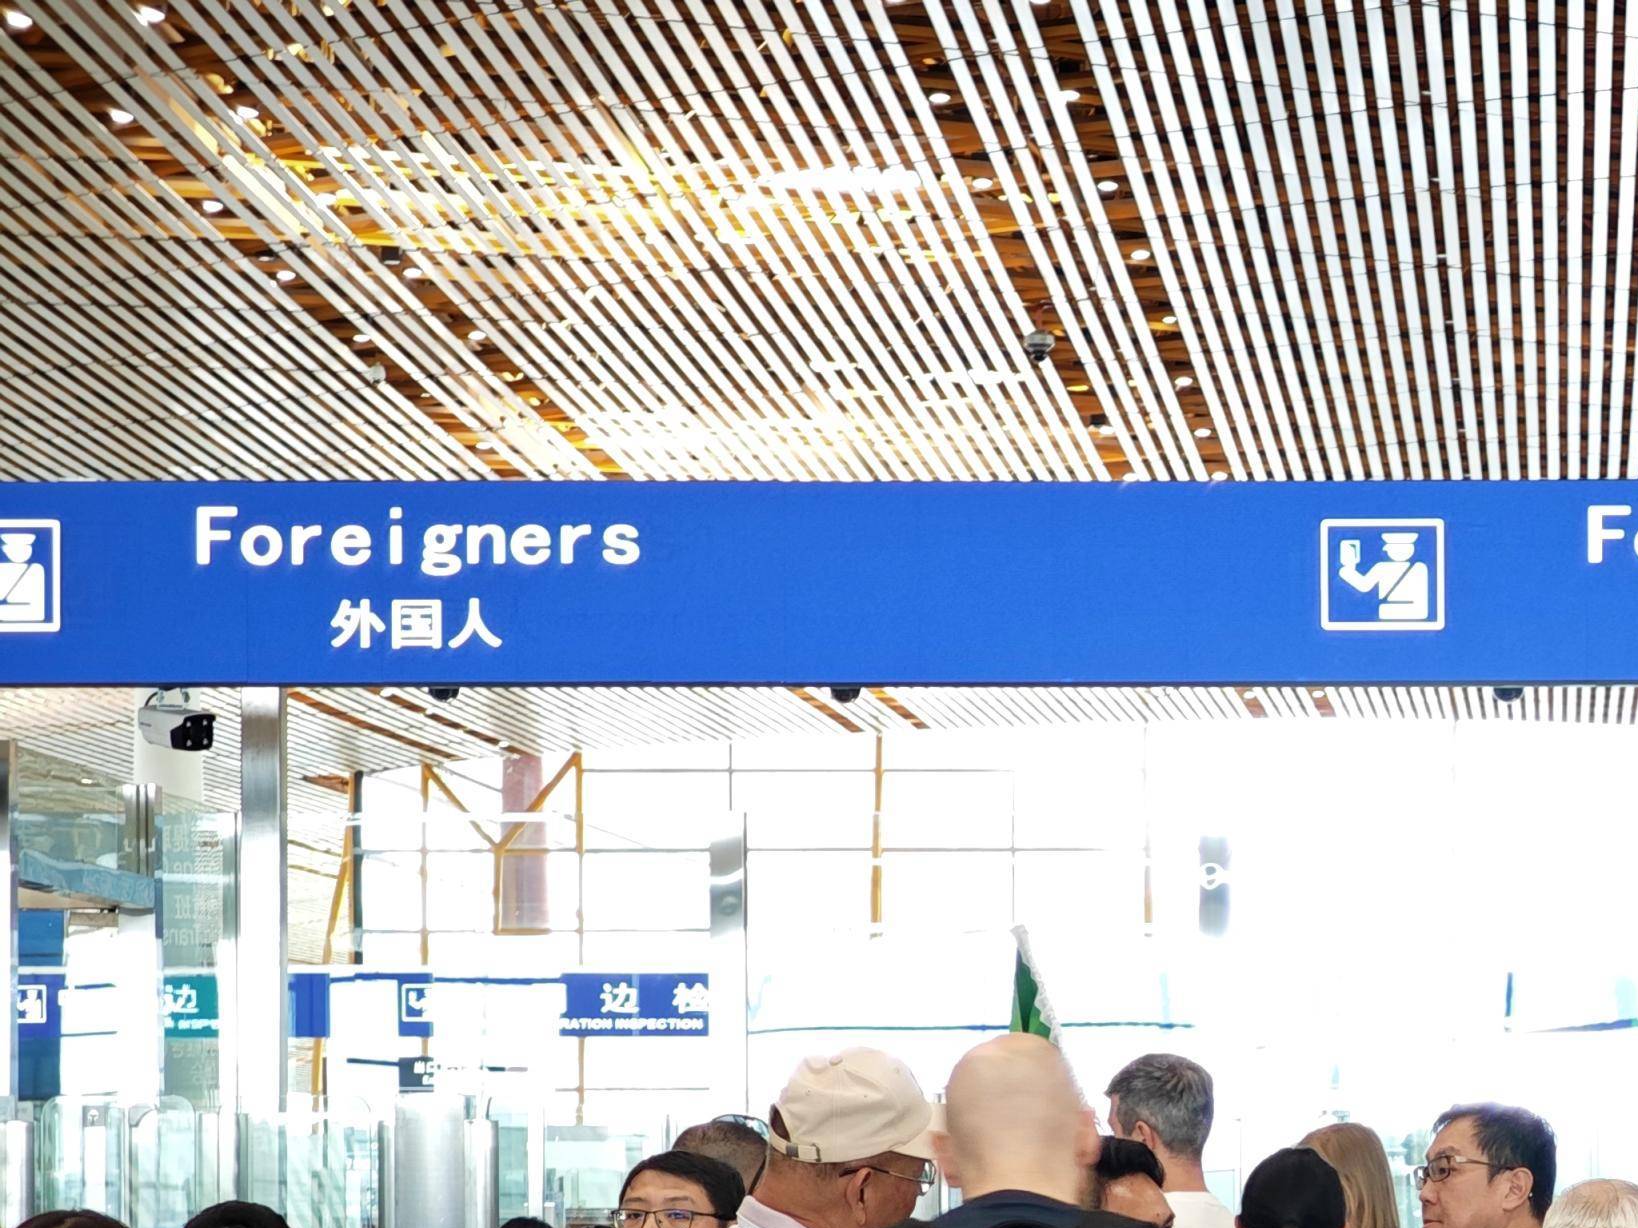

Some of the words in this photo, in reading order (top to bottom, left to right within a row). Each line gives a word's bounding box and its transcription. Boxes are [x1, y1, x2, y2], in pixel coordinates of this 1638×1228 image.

[195, 505, 641, 577] Foreigners
[330, 597, 503, 650] 外国人
